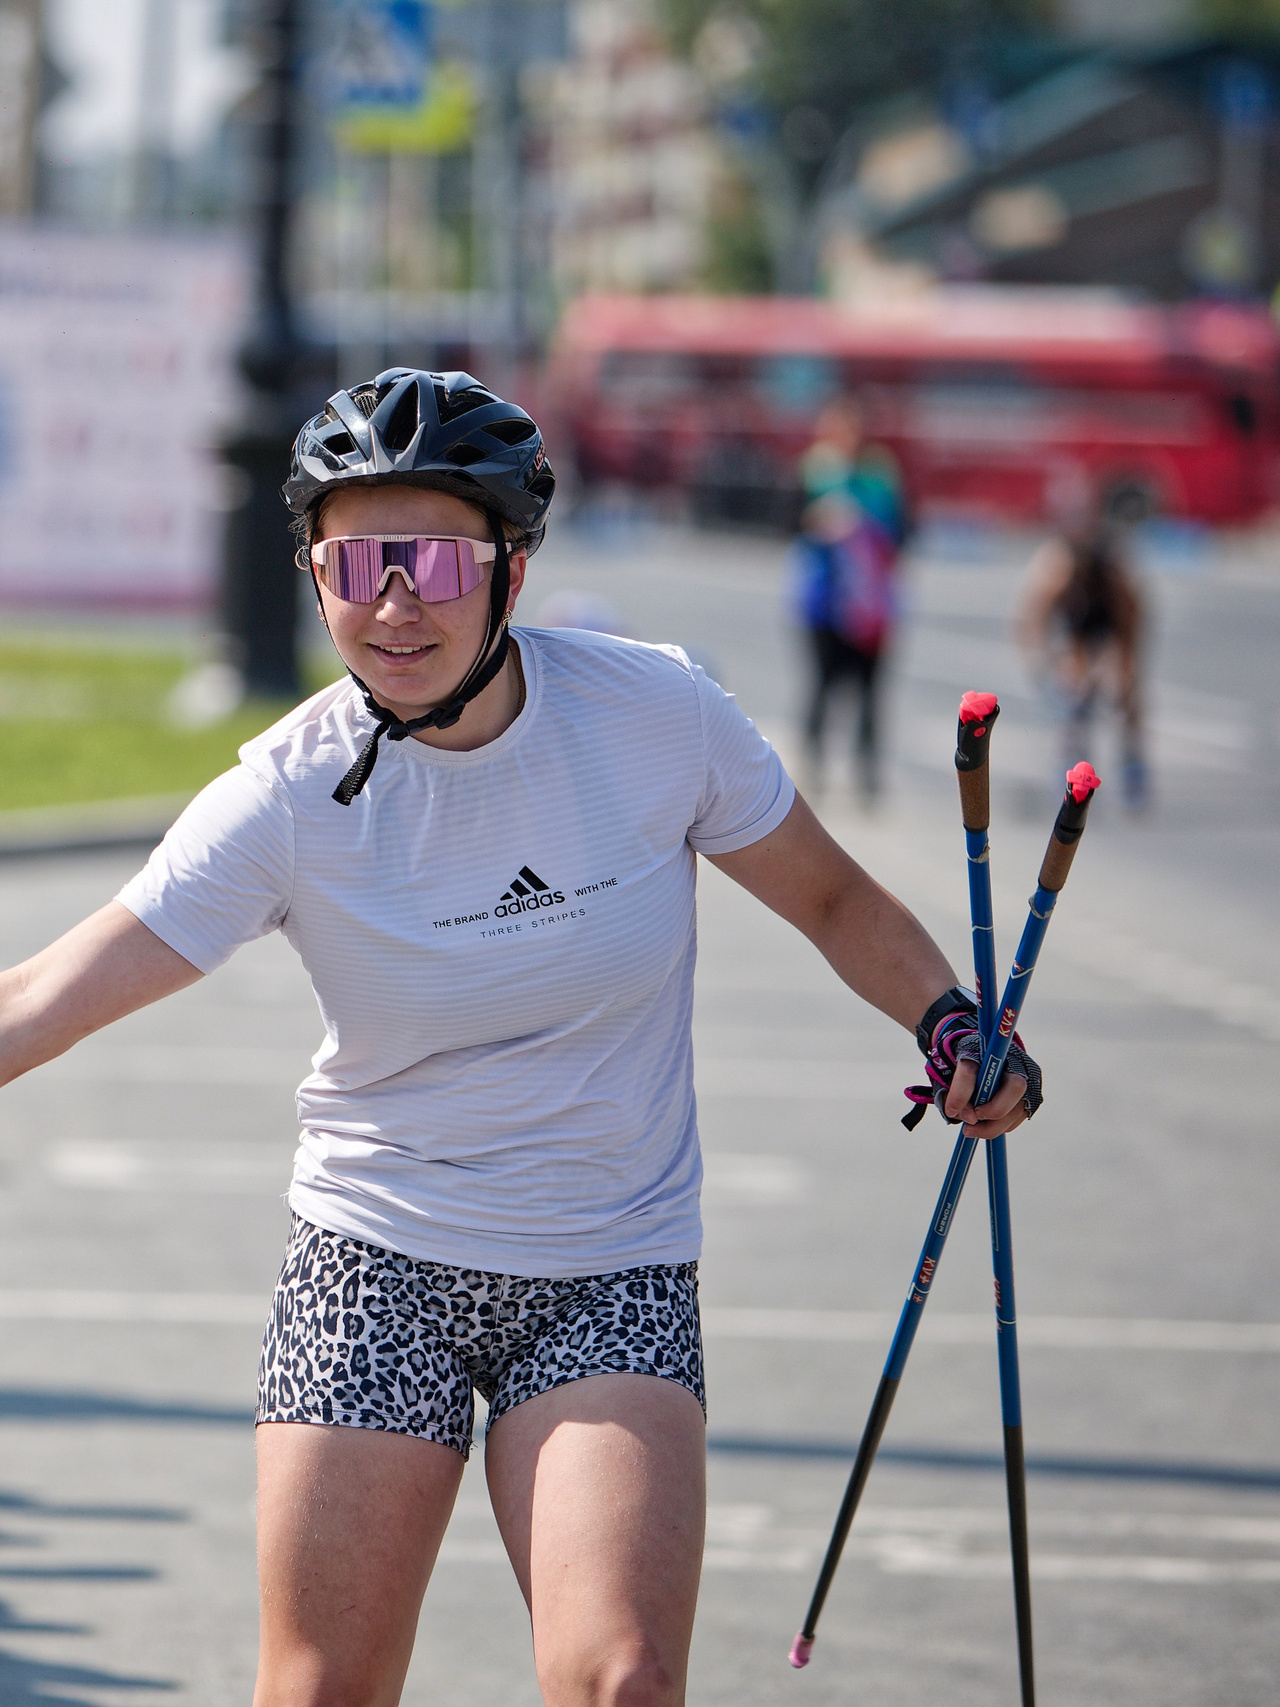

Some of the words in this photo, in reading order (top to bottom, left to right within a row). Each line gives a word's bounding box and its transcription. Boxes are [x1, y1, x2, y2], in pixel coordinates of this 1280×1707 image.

[432, 918, 452, 929] THE
[454, 911, 489, 926] BRAND
[494, 890, 566, 918] adidas
[574, 884, 599, 897] WITH
[600, 877, 618, 890] THE
[480, 924, 522, 939] THREE
[531, 908, 587, 928] STRIPES
